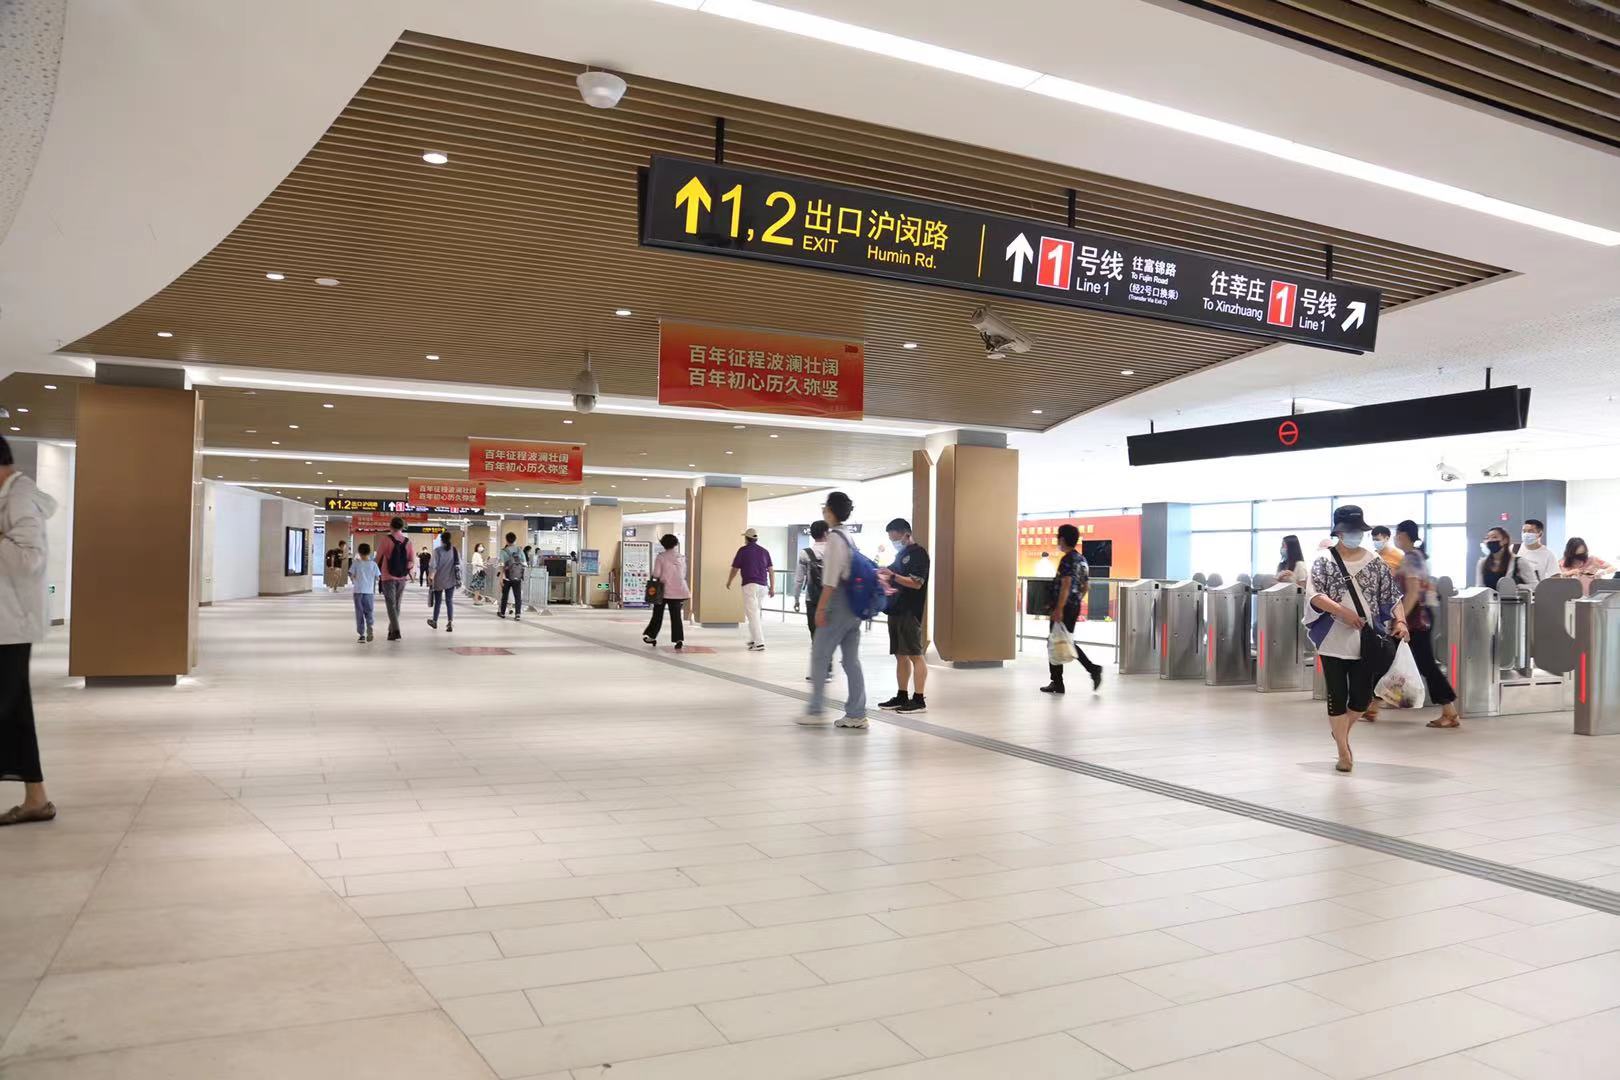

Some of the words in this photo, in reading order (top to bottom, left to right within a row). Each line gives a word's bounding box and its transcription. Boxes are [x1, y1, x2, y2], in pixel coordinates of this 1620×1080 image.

[721, 183, 797, 246] 1,2
[803, 236, 839, 254] EXIT
[867, 245, 911, 266] Humin
[914, 252, 937, 269] Rd.
[1077, 245, 1124, 281] 号线
[1131, 271, 1138, 280] To
[1138, 273, 1152, 283] Fujin
[1153, 276, 1168, 285] Road
[1132, 256, 1176, 277] 往富锦路
[1076, 277, 1101, 293] Line
[1103, 281, 1110, 296] 1
[1210, 269, 1266, 303] 往莘庄
[1202, 297, 1213, 310] To
[1215, 300, 1263, 321] Xinzhuang
[1300, 288, 1337, 319] 号线
[1299, 316, 1319, 330] Line
[1320, 320, 1326, 332] 1
[688, 344, 839, 377] 百年征程波澜壮阔
[688, 367, 839, 398] 百年初心历久弥坚
[484, 460, 569, 475] 百年初心历久弥坚
[485, 449, 569, 464] 百年征程波澜壮阔
